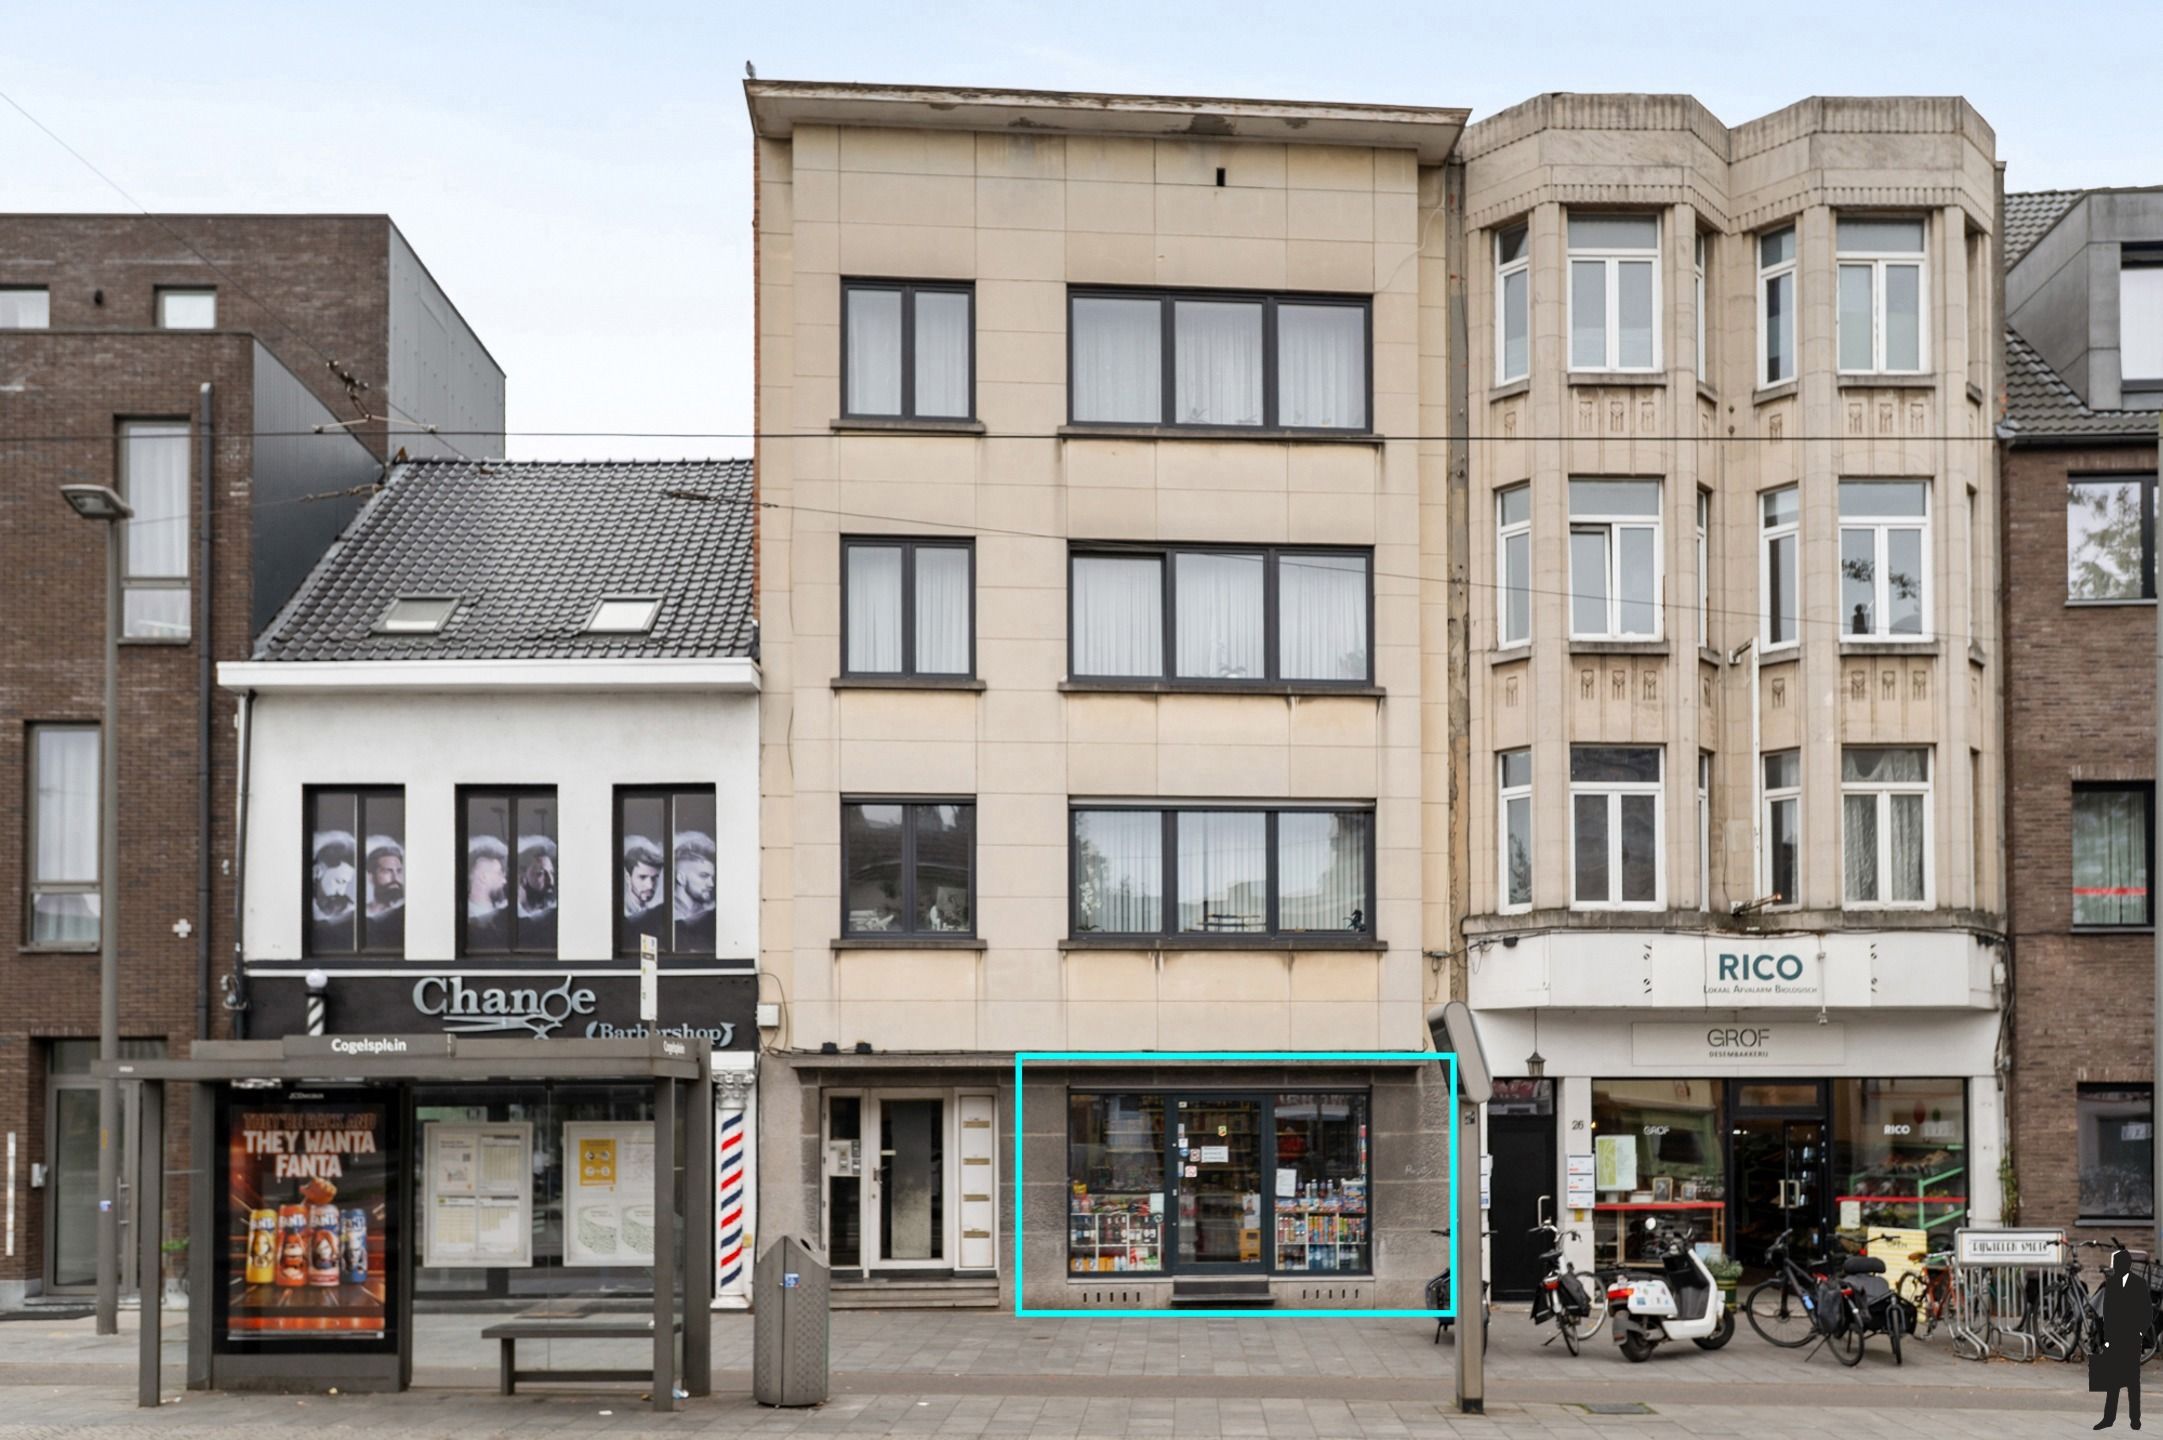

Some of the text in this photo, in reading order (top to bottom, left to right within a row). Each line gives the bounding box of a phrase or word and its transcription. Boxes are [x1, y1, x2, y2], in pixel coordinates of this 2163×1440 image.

[1718, 954, 1803, 981] RICO
[331, 1037, 407, 1055] Cogelsplein
[1707, 1028, 1770, 1047] GROF
[1572, 1120, 1584, 1130] 26
[1884, 1124, 1911, 1135] RICO
[243, 1131, 376, 1153] THEY WANTA
[276, 1154, 343, 1178] FANTA
